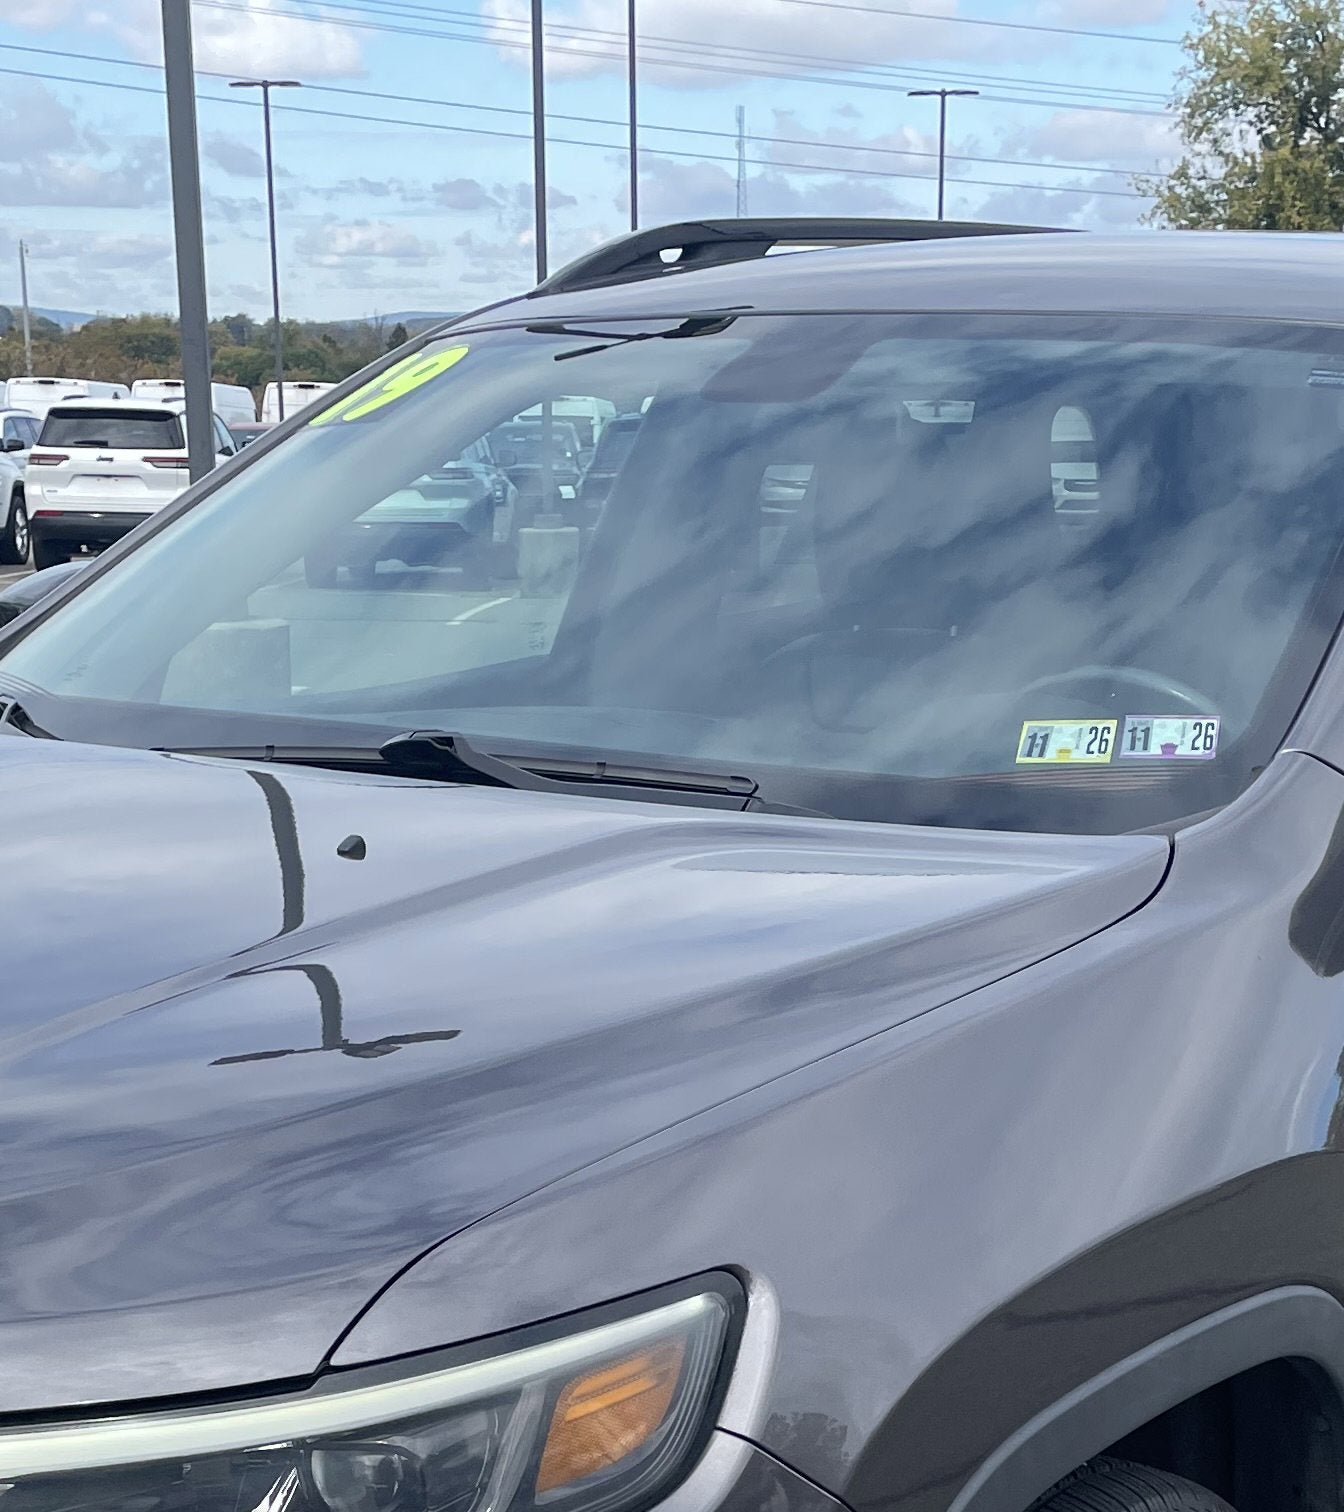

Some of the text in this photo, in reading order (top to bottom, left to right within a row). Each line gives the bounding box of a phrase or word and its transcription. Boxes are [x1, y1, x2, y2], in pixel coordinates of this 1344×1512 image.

[308, 345, 470, 427] 19
[1026, 732, 1050, 758] 11
[1086, 726, 1111, 755] 26
[1127, 726, 1151, 751] 11
[1191, 721, 1215, 751] 26
